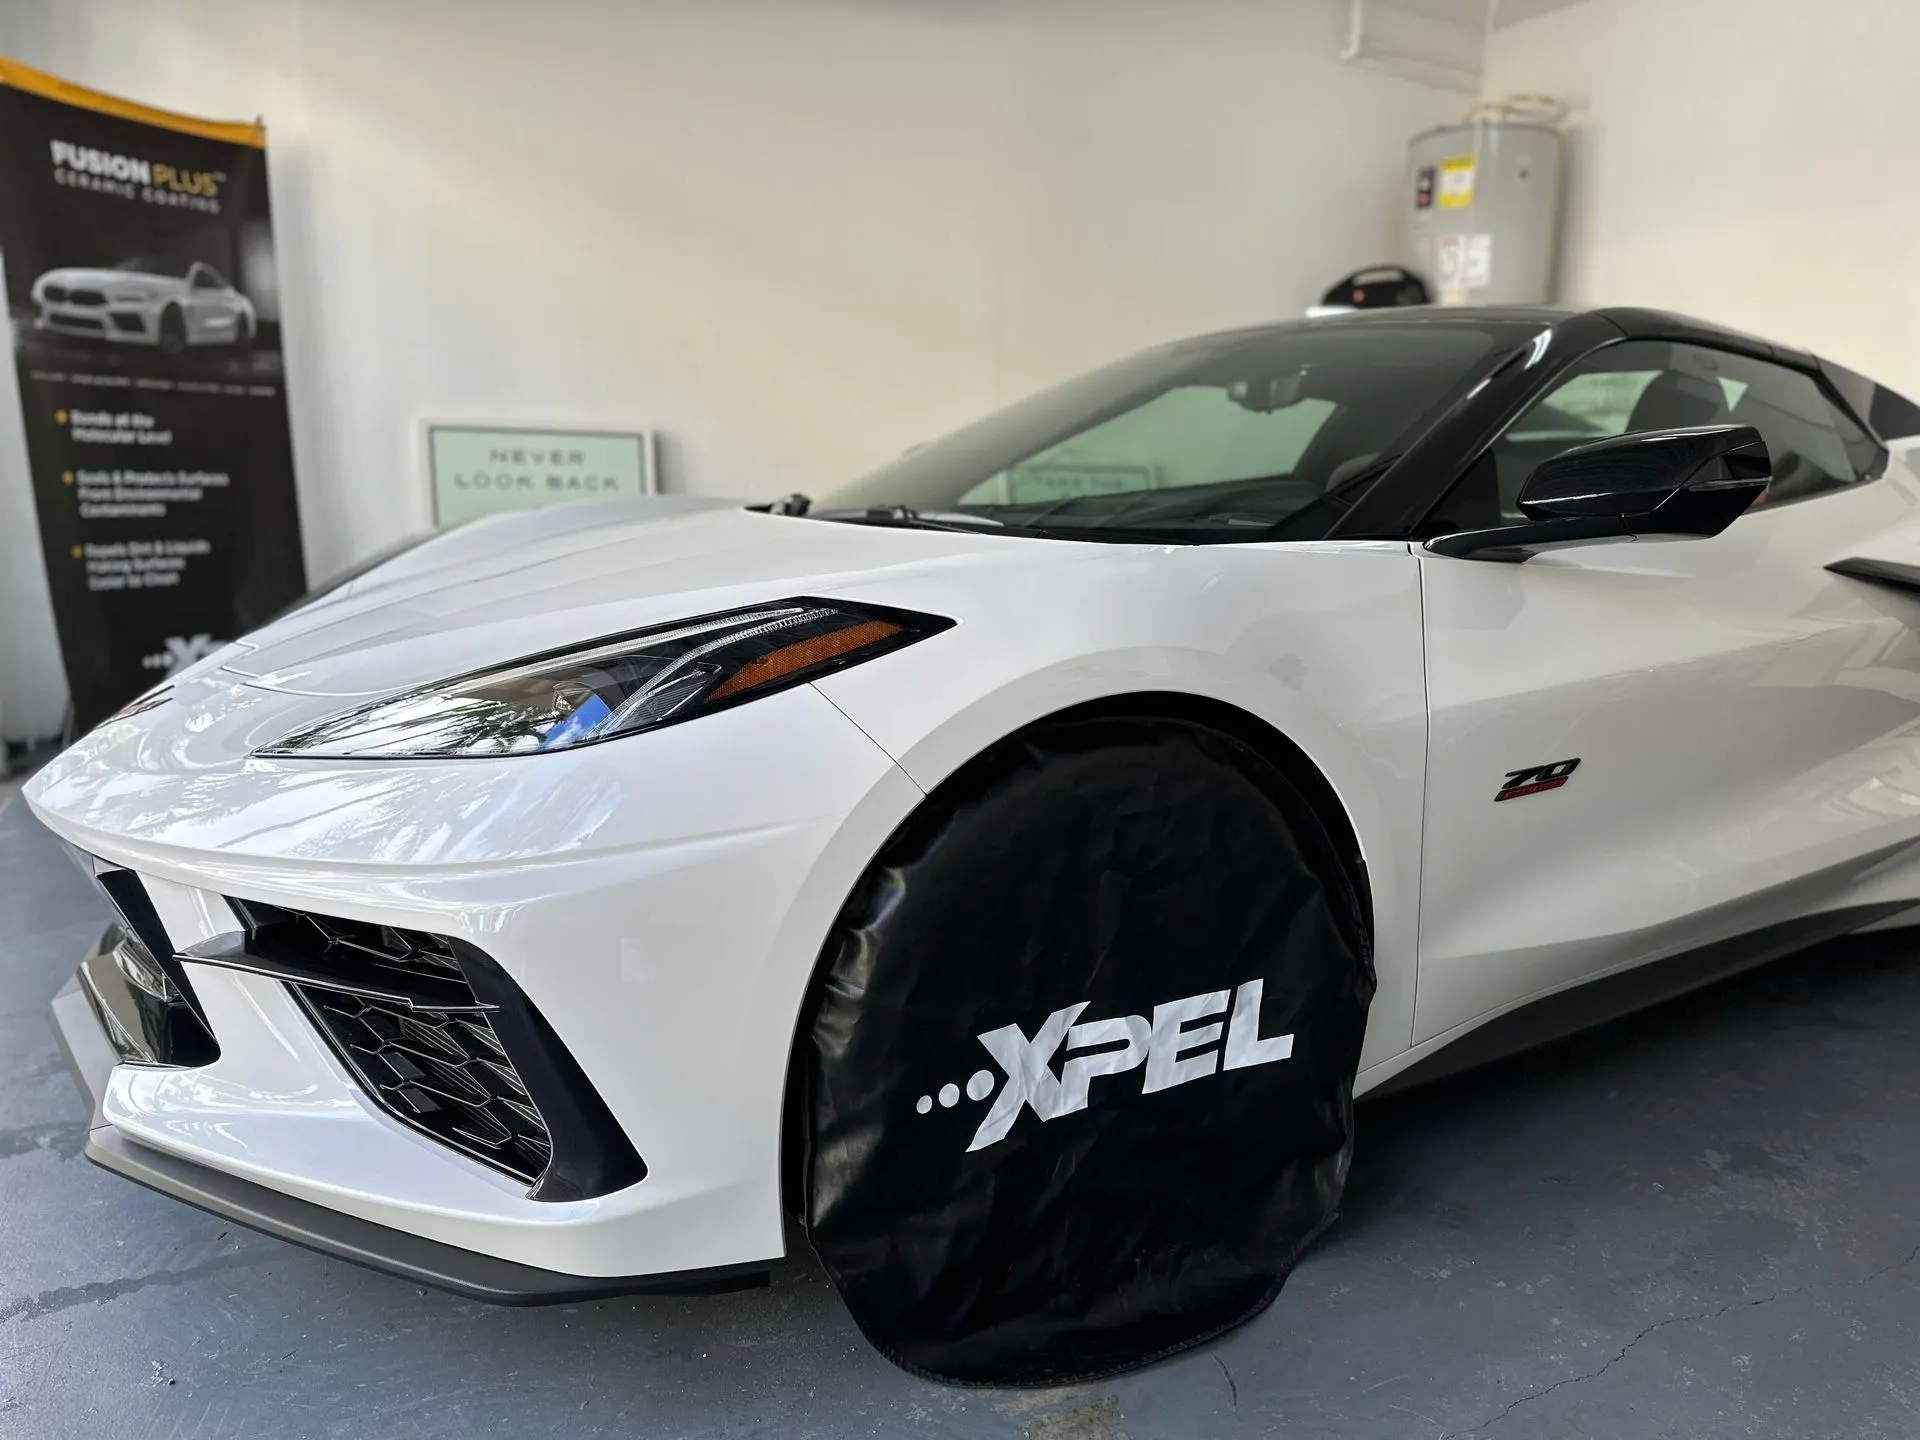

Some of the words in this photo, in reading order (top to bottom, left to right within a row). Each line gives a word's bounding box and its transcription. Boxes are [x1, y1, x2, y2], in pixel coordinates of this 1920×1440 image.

[51, 139, 151, 184] FUSION
[54, 167, 136, 199] CERAMIC
[141, 186, 221, 215] COATING
[489, 448, 586, 466] NEVER
[453, 472, 534, 490] LOOK
[546, 474, 620, 492] BACK
[1502, 757, 1581, 789] 70
[965, 978, 1294, 1152] XPEL
